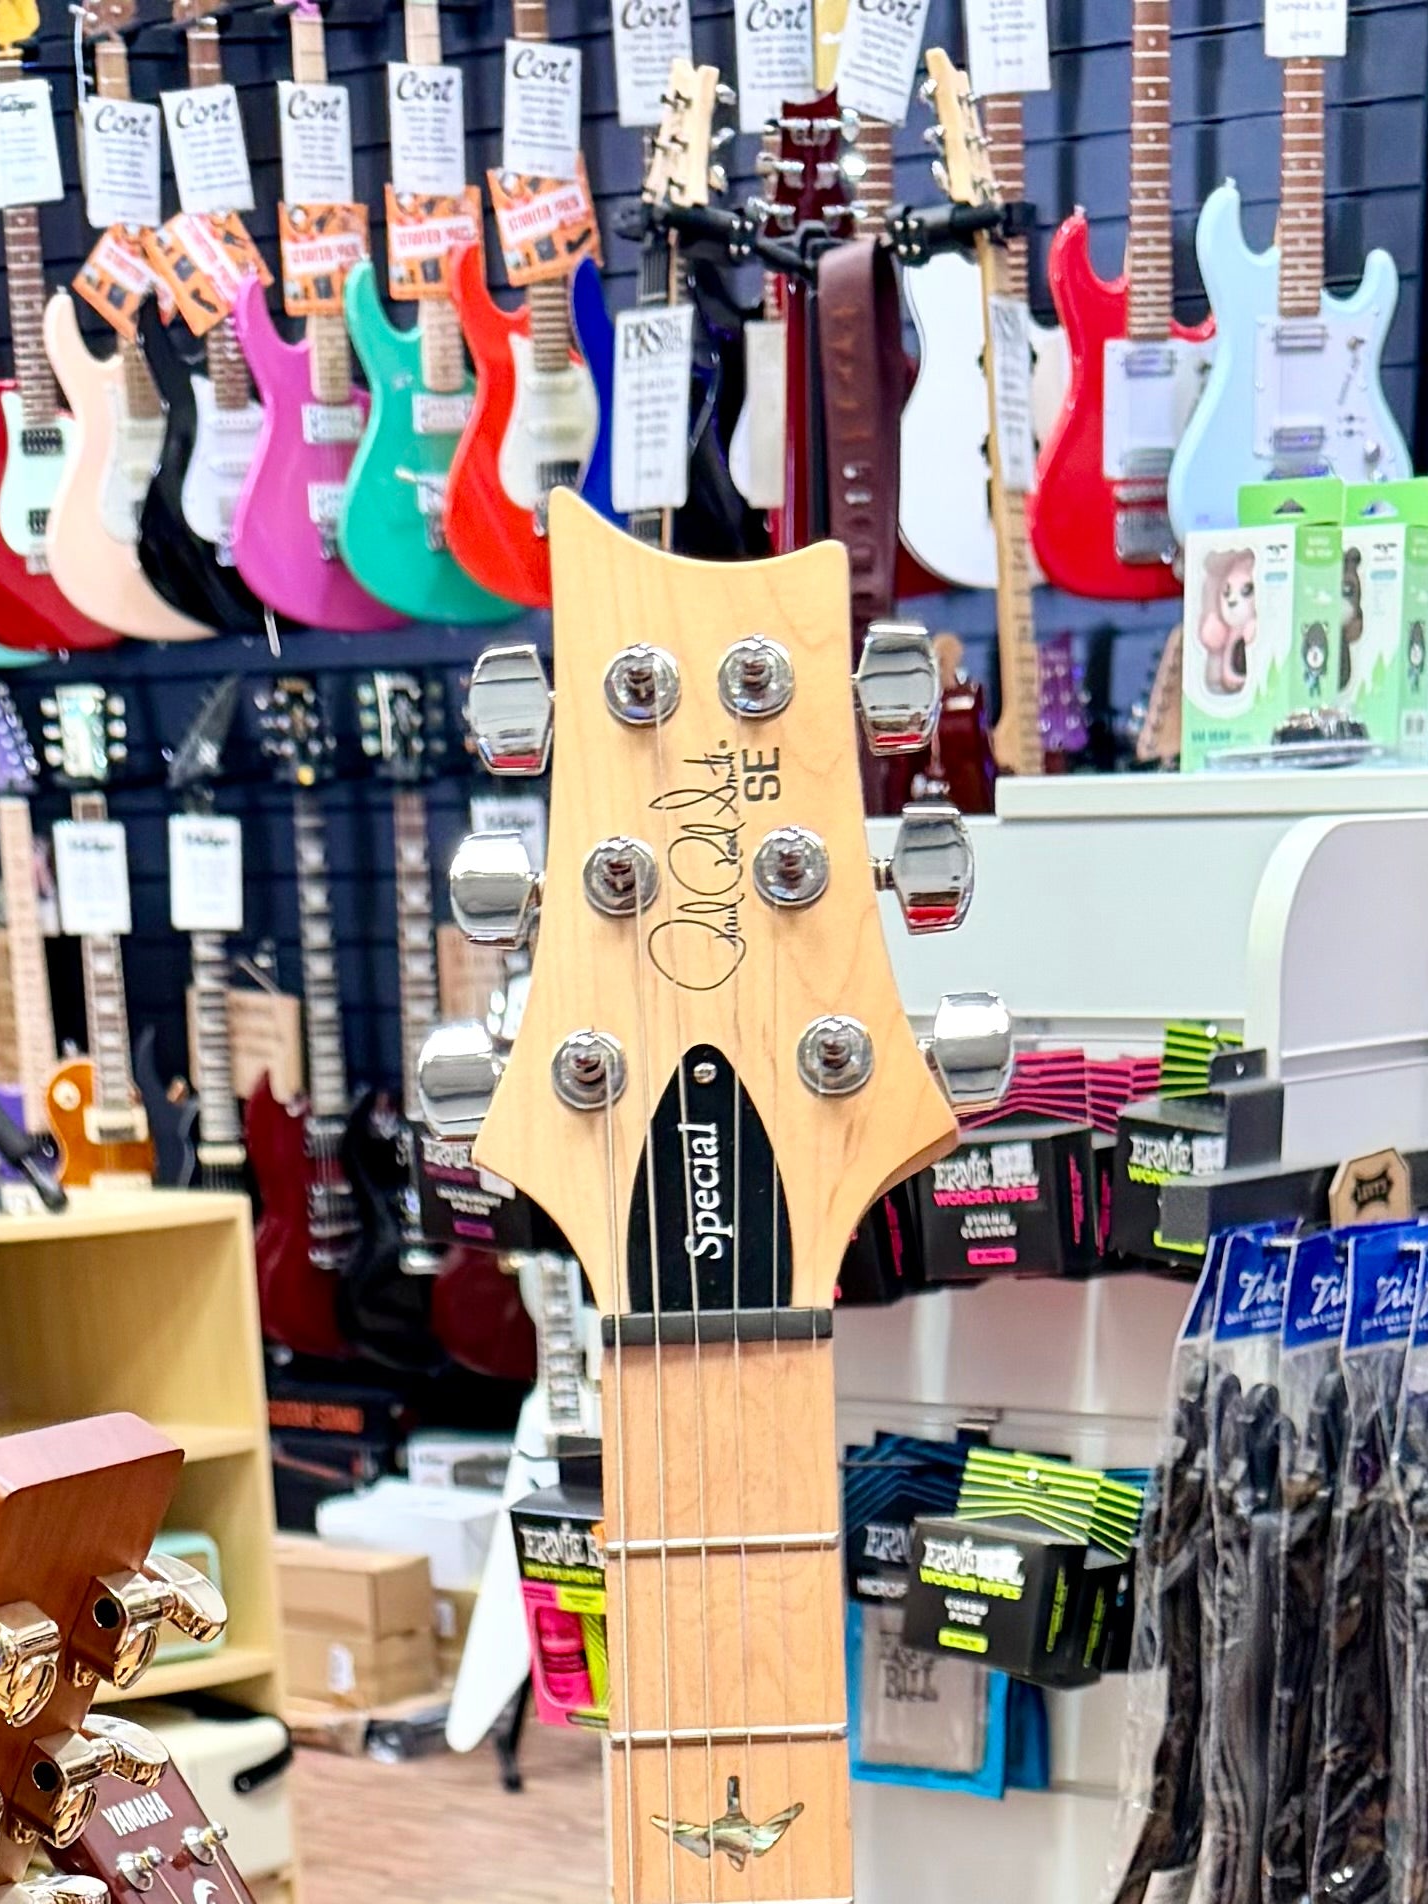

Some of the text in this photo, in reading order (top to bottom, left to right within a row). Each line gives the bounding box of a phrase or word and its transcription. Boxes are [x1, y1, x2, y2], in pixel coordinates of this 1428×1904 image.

[397, 71, 454, 102] Cort
[513, 49, 573, 84] Cort
[95, 105, 152, 137] Cort
[176, 97, 232, 129] Cort
[288, 91, 341, 121] Cort
[741, 746, 781, 802] SE
[932, 1150, 992, 1191] ERNIE
[1129, 1131, 1192, 1173] ERNIE
[678, 1122, 733, 1260] Special
[519, 1521, 588, 1566] ERNIE
[101, 1791, 174, 1837] YAMAHA
